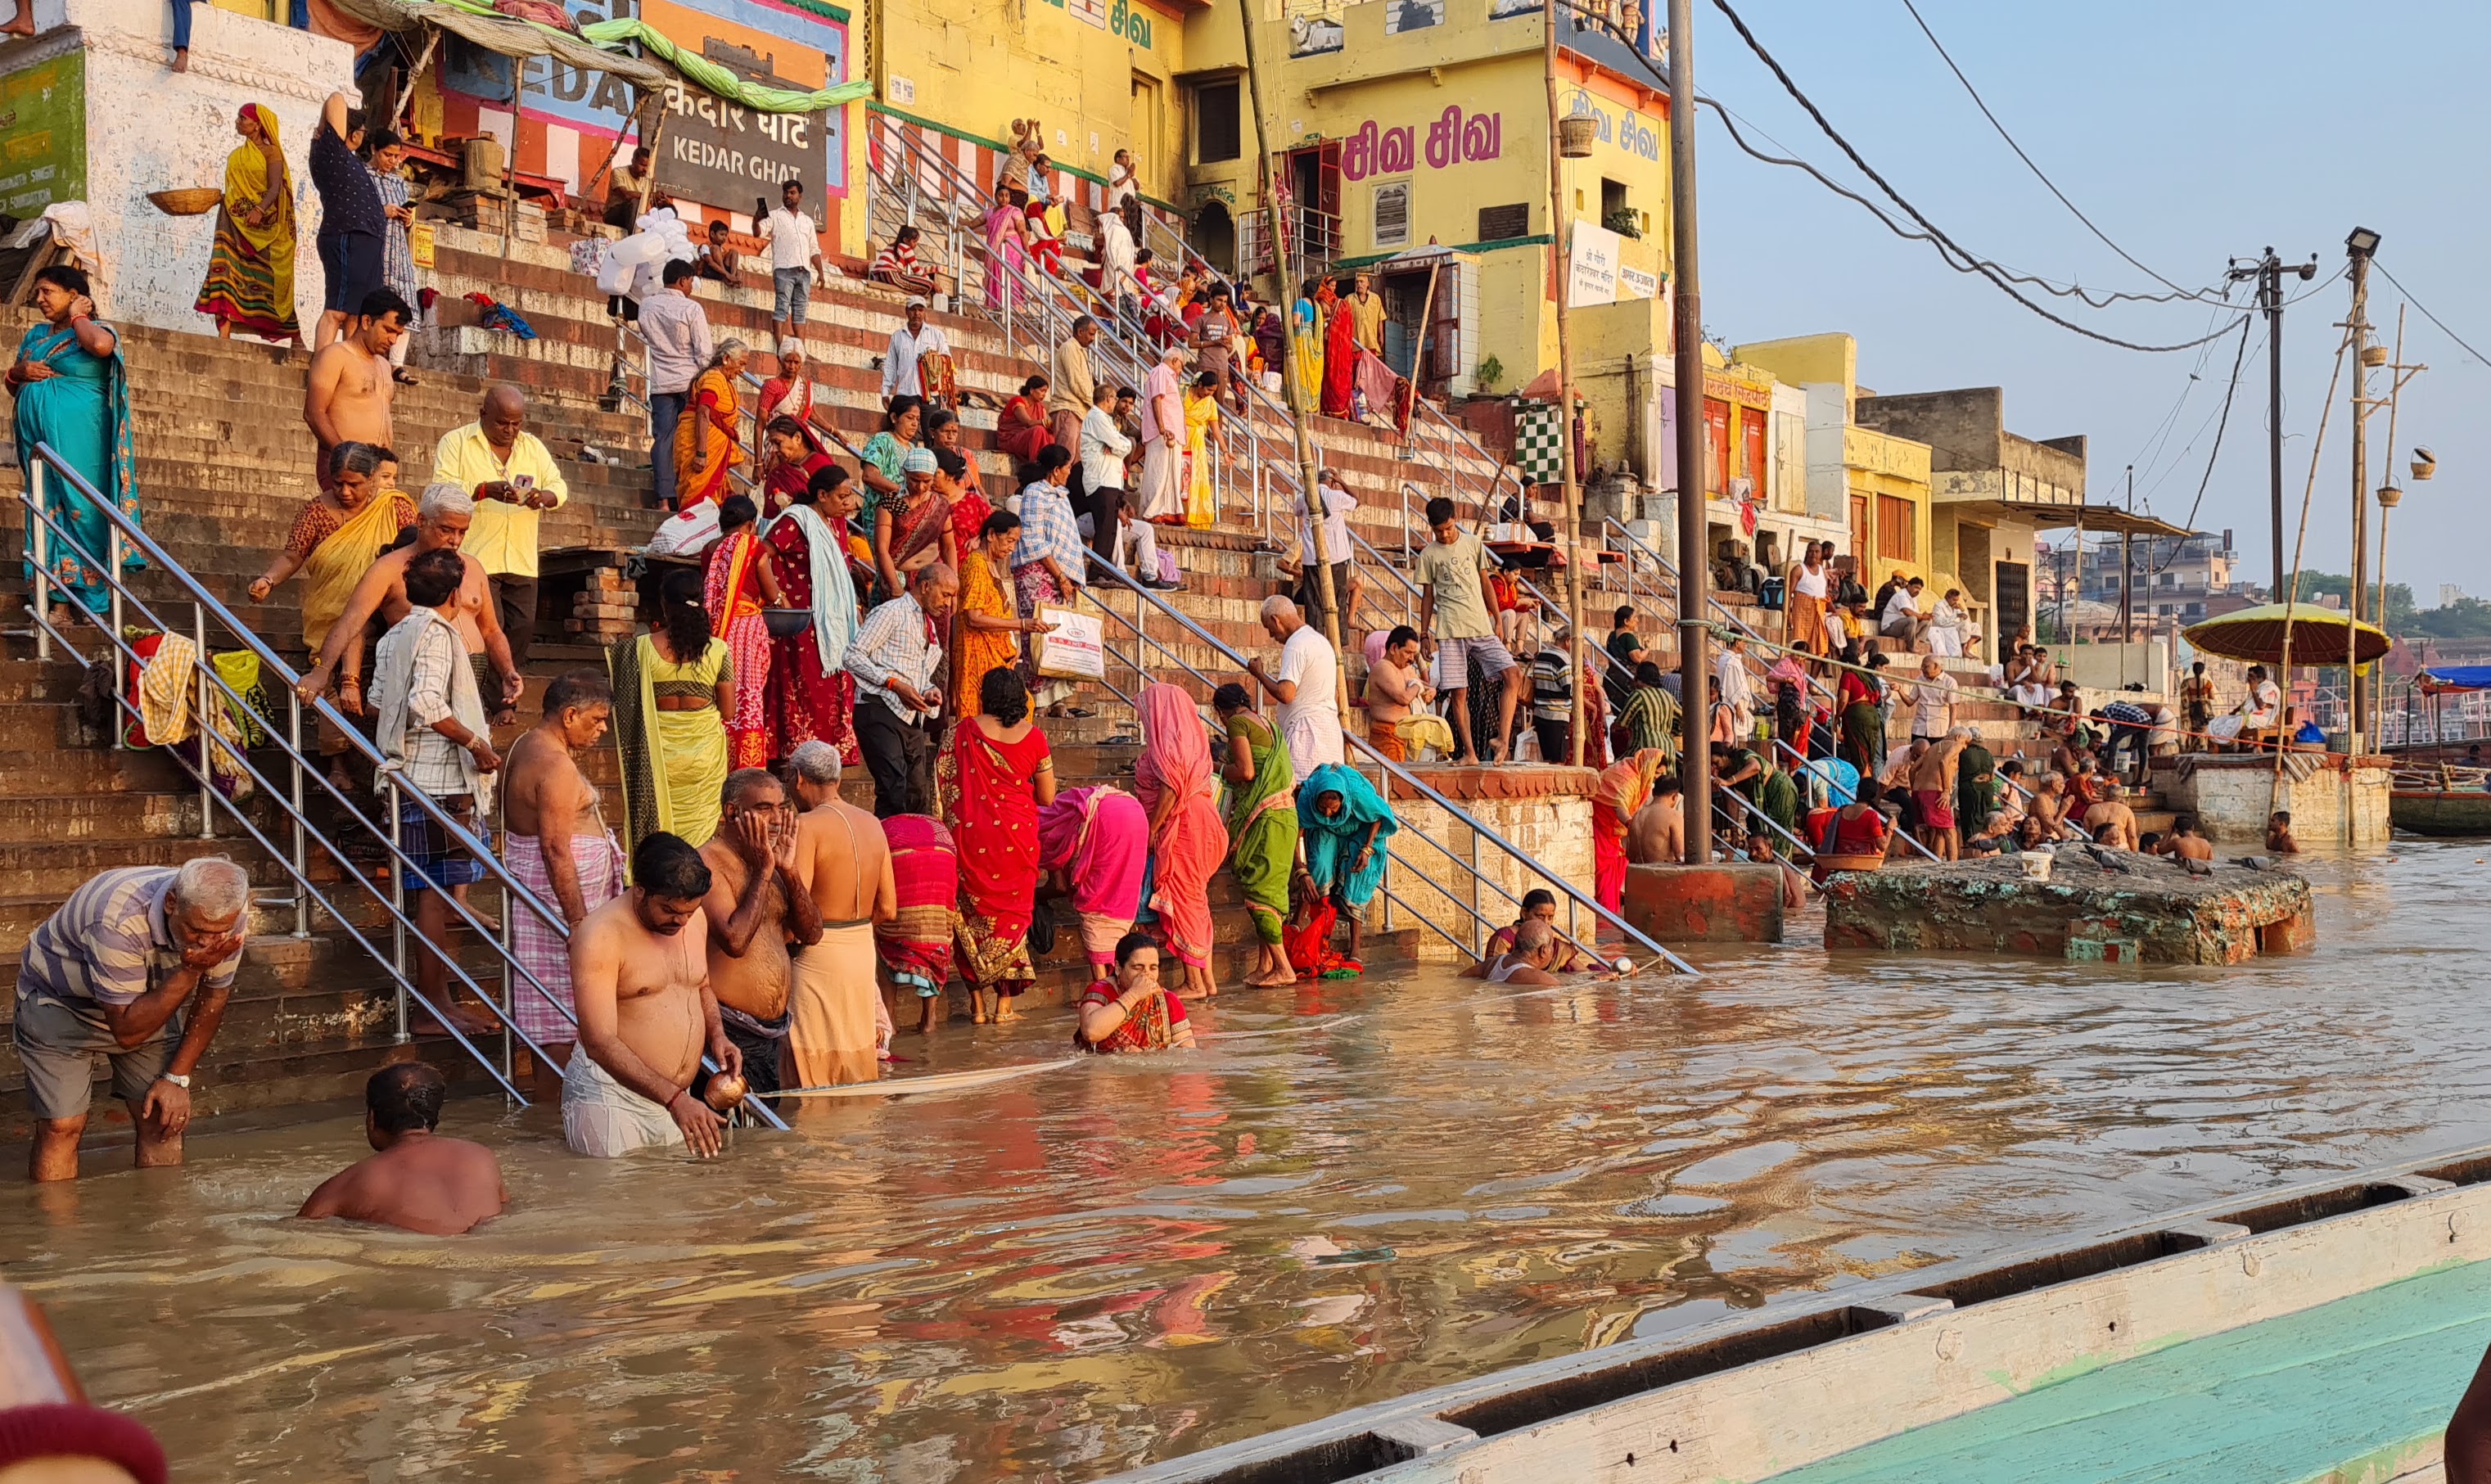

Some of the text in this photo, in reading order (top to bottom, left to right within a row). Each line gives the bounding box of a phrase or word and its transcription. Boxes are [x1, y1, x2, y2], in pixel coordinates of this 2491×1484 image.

[1111, 0, 1151, 50] சிவ
[673, 135, 801, 185] KEDAR GHAT
[1342, 105, 1500, 181] சிவ சிவ
[1620, 111, 1658, 162] சிவ
